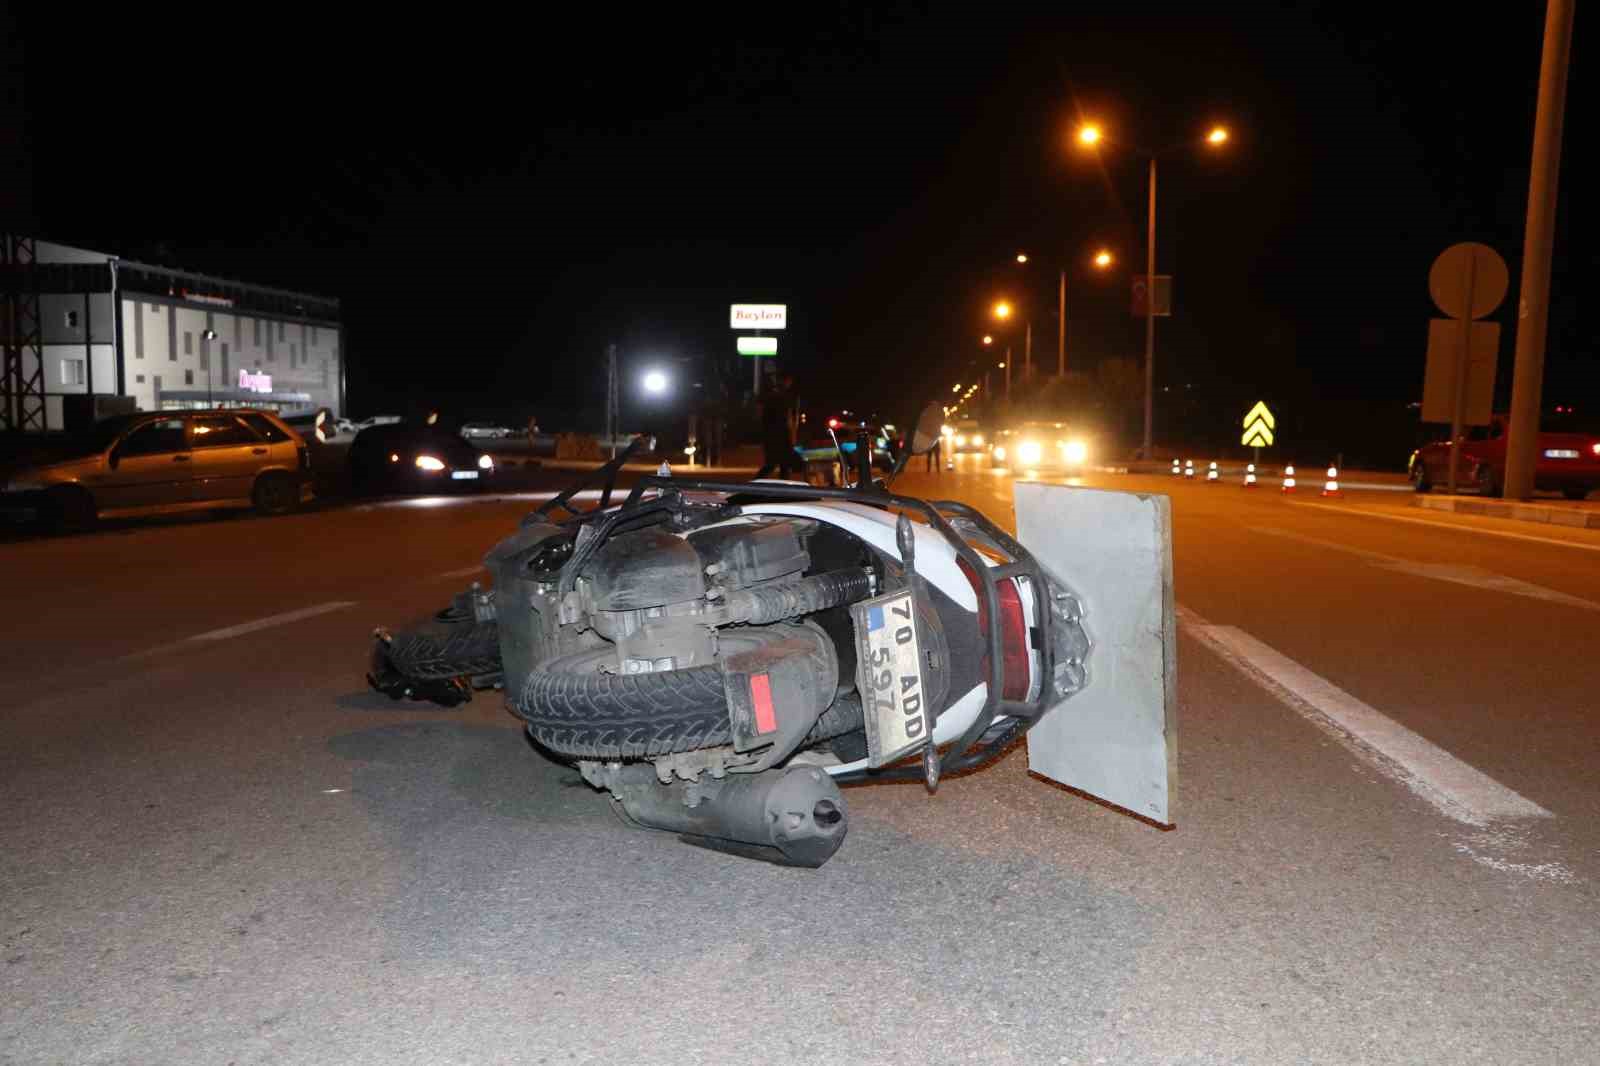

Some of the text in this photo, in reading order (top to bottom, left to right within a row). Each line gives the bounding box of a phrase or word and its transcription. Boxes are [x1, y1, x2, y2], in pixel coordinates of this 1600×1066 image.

[871, 647, 896, 712] 597
[892, 600, 923, 738] 70 ADD
